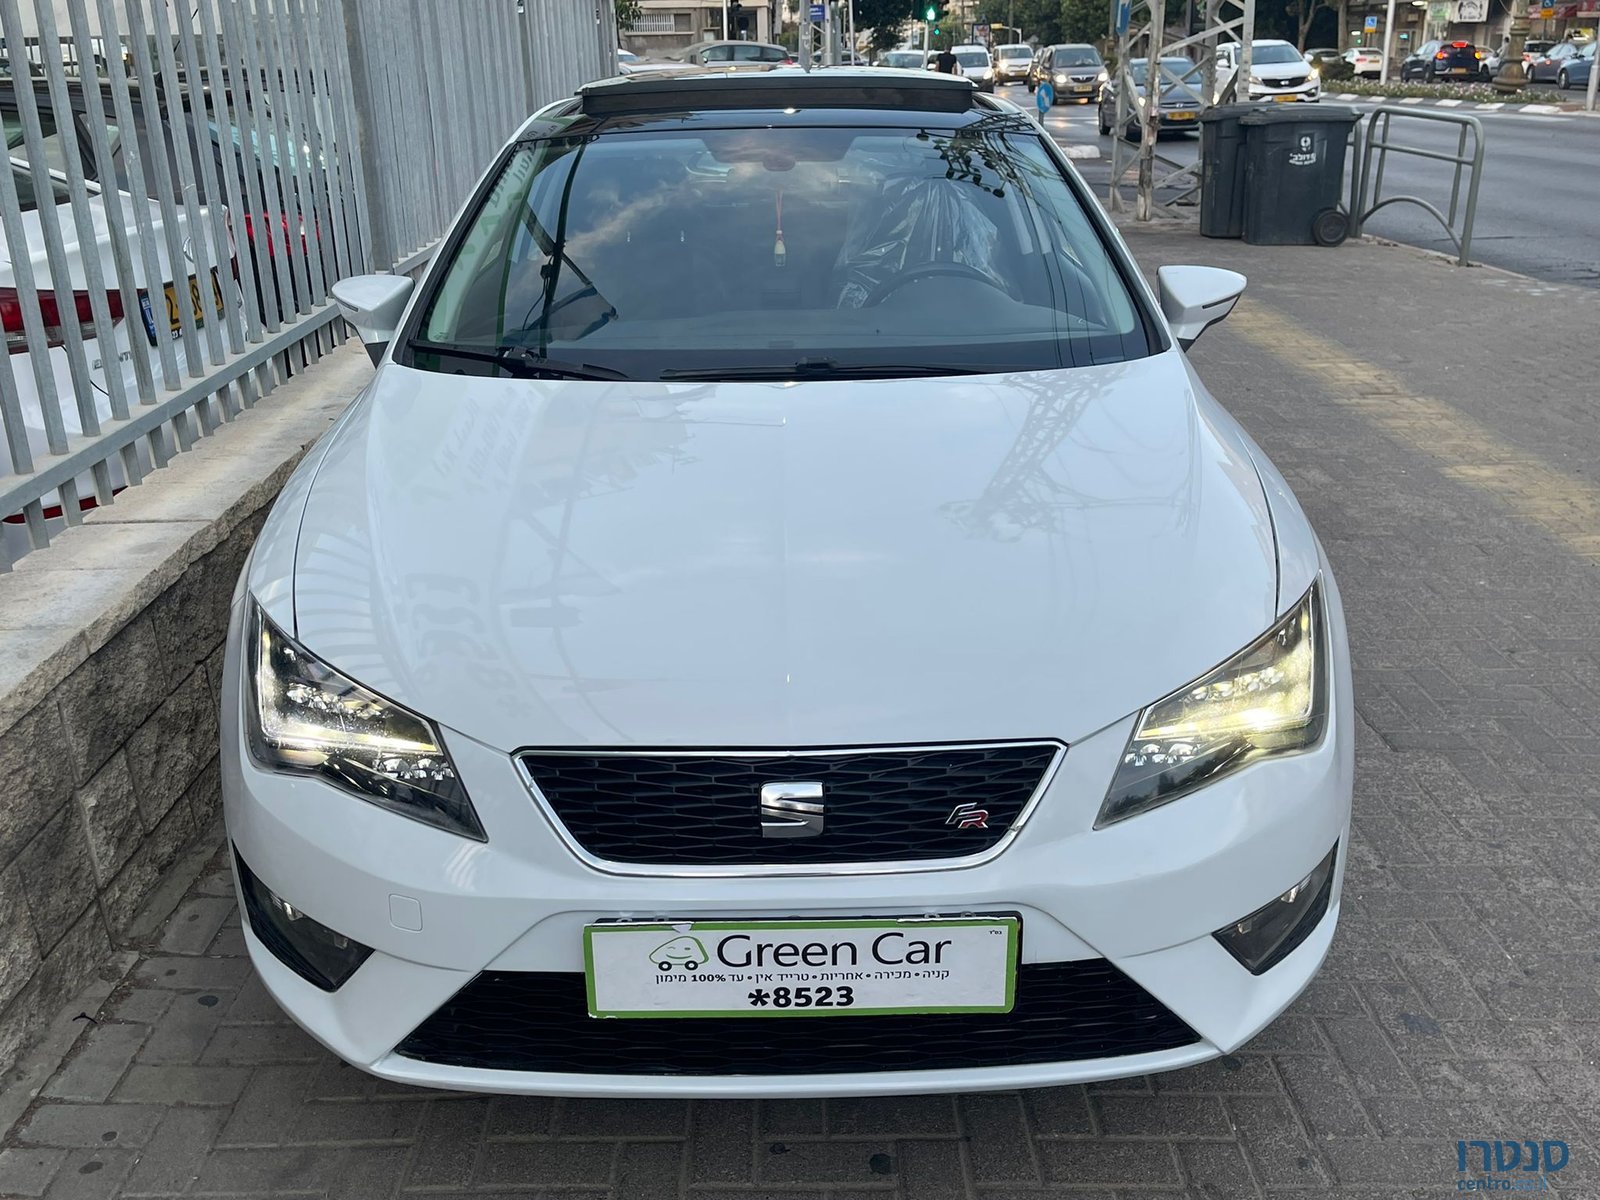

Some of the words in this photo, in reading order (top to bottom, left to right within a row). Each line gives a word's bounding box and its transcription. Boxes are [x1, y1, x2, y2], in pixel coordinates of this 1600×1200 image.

[945, 802, 989, 829] FR
[717, 934, 857, 968] Green
[872, 931, 952, 965] Car
[655, 974, 687, 985] מימון
[691, 973, 727, 983] 100%
[728, 974, 745, 983] עד
[755, 973, 773, 984] אין
[776, 973, 810, 982] טרייד
[820, 971, 864, 981] אחריות
[874, 971, 912, 980] מכירה
[922, 970, 950, 980] קניה
